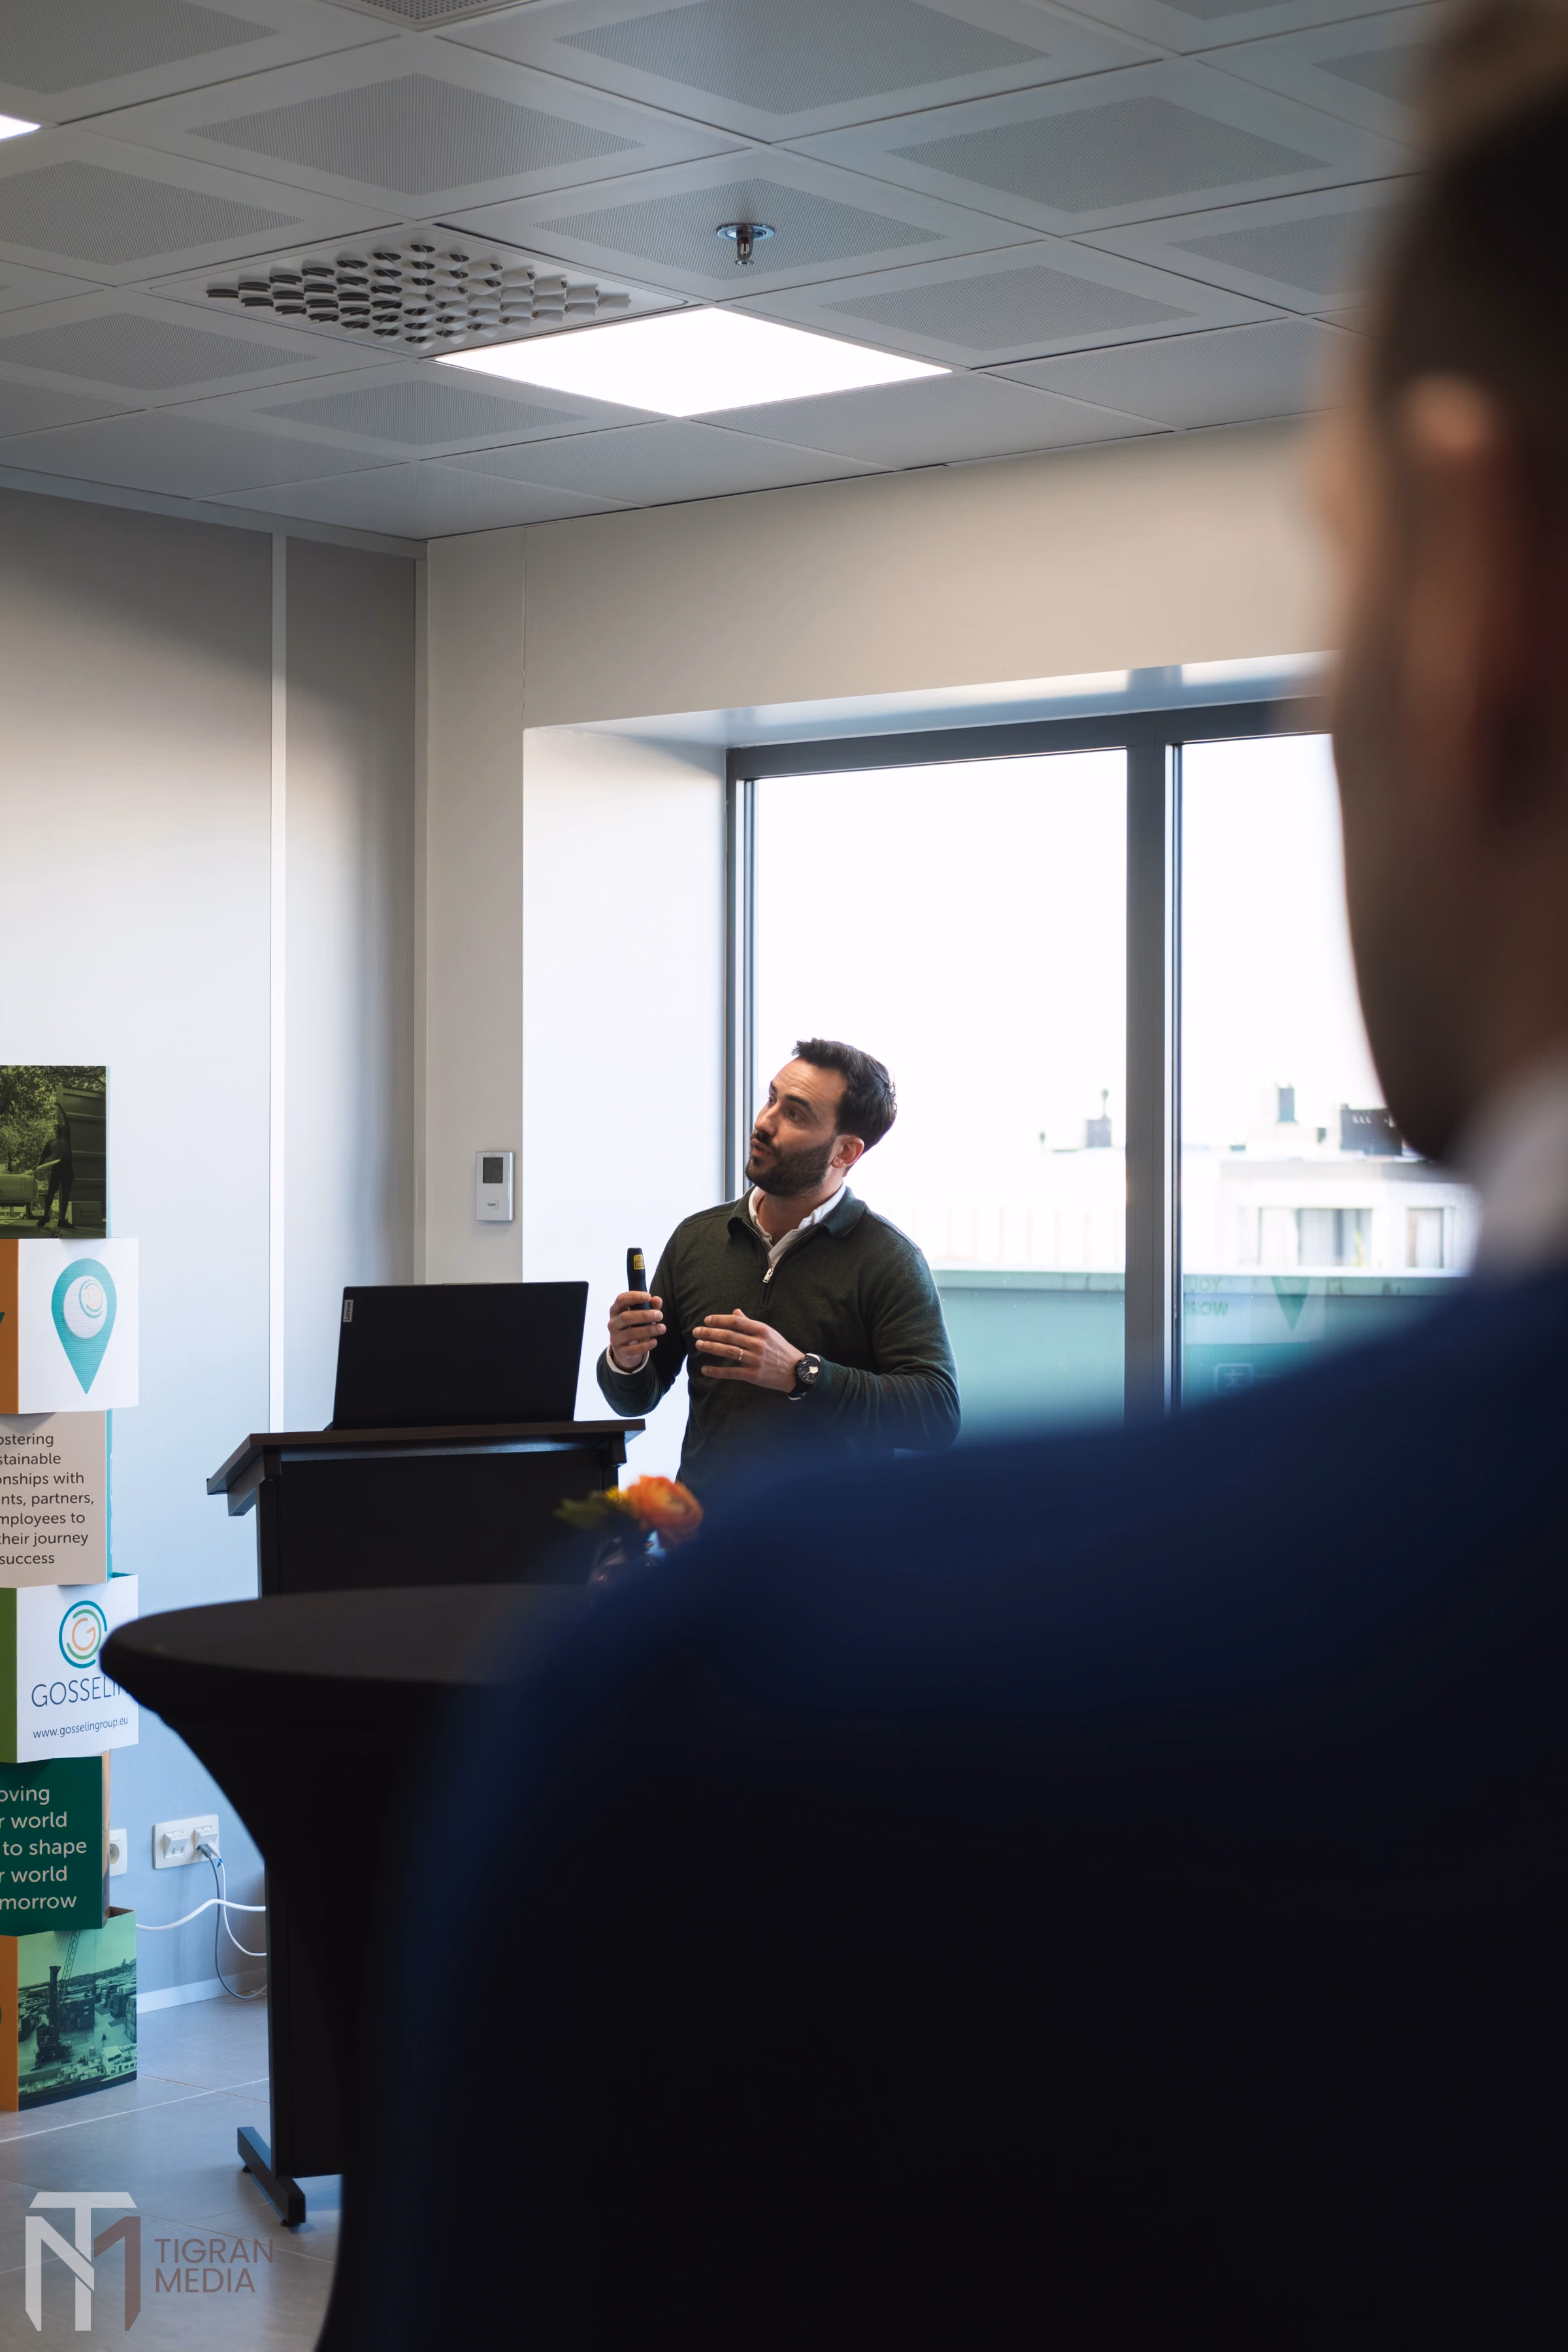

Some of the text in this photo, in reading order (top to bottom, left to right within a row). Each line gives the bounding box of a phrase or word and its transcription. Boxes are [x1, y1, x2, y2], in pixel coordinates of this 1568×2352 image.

[0, 1472, 84, 1487] nships with
[0, 1493, 94, 1507] nts, partners,
[71, 1512, 86, 1524] to
[0, 1532, 89, 1547] heir journey
[0, 1554, 55, 1565] success
[31, 1676, 122, 1707] GOSSELI
[33, 1716, 129, 1739] www.gosselingroup.eu
[10, 1811, 67, 1829] world
[3, 1839, 87, 1859] to shape
[10, 1865, 67, 1883] world
[0, 1896, 77, 1910] morrow
